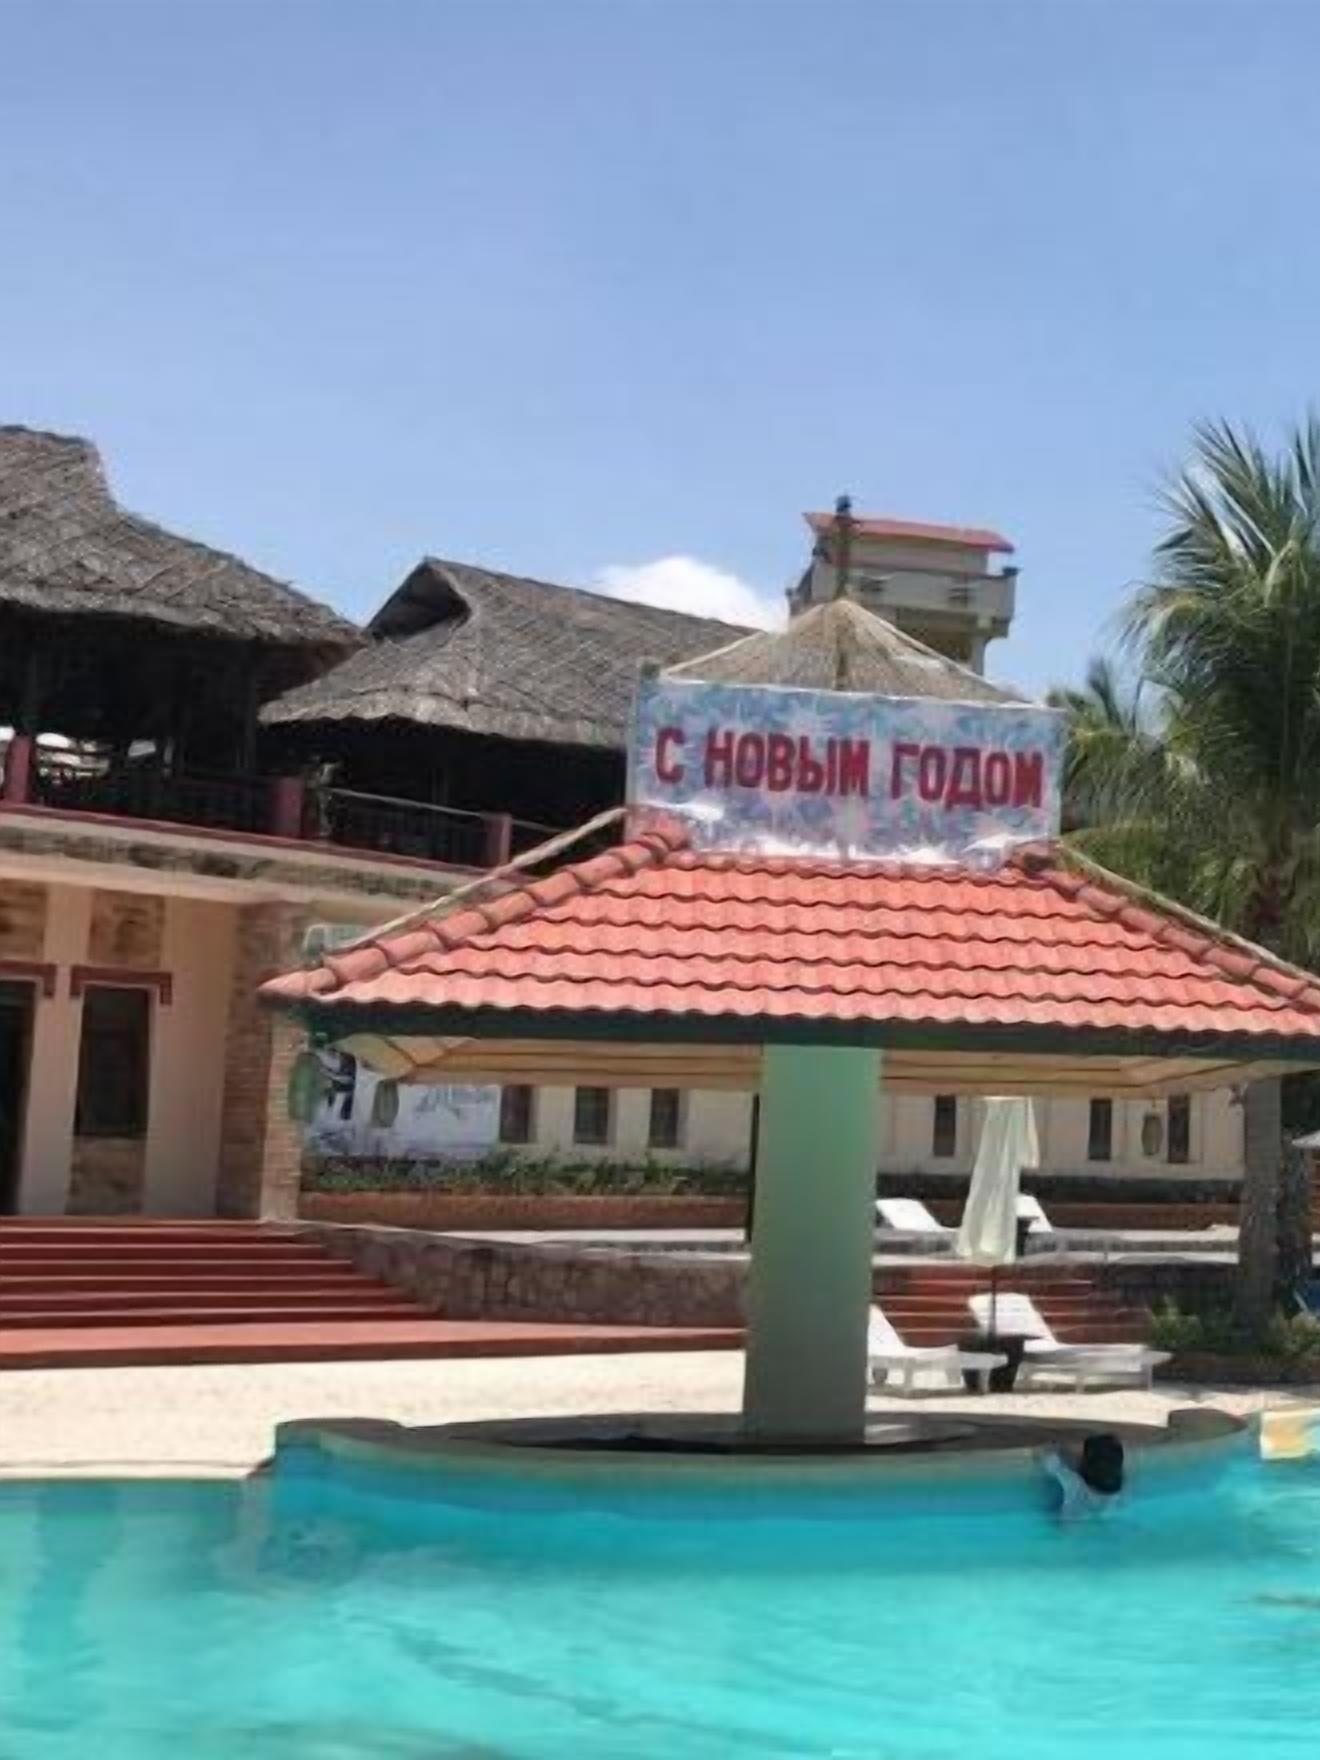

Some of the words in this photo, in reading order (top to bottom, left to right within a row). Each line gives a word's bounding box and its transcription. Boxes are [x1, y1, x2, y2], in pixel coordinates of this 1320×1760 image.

[655, 728, 685, 783] С
[703, 728, 871, 796] НОВЫМ
[891, 742, 1044, 811] ГОДОМ
